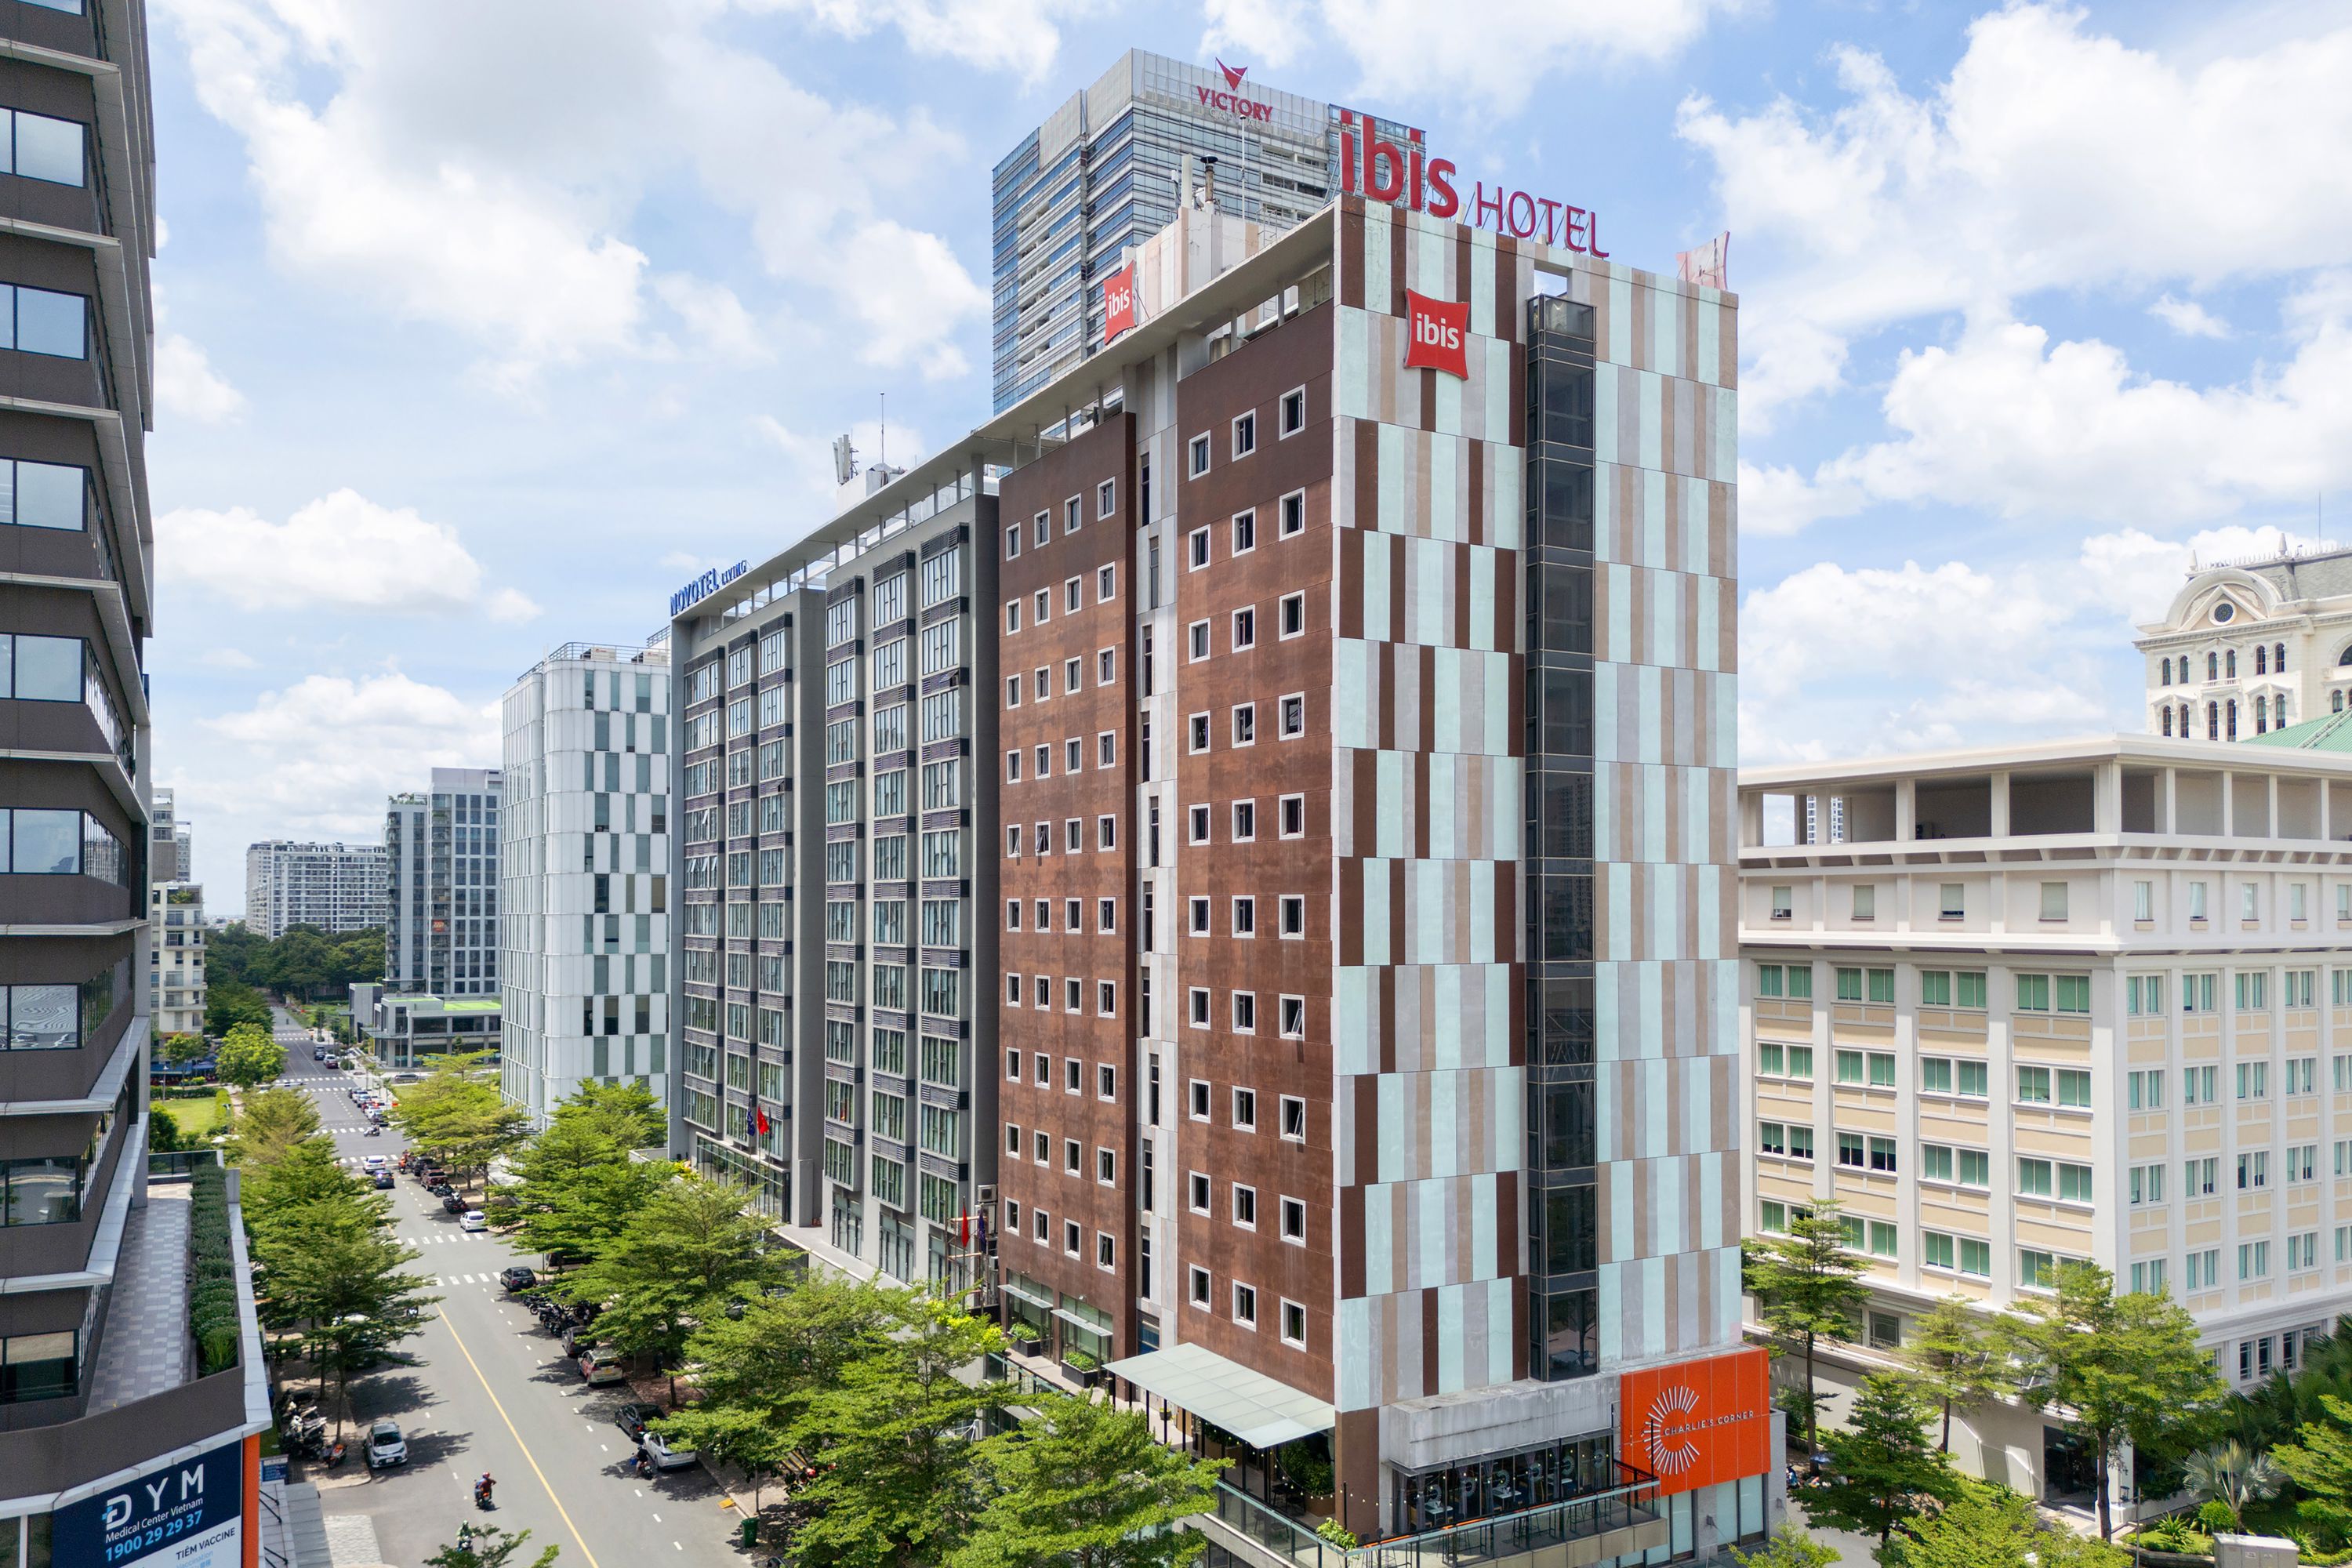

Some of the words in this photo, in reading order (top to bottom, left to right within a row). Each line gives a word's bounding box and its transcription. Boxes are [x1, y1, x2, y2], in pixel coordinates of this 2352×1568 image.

[1196, 85, 1273, 122] VICTORY
[1209, 108, 1261, 129] CAPAL
[1339, 109, 1459, 219] ibis
[1475, 181, 1610, 259] HOTEL
[1107, 286, 1131, 319] ibis
[1416, 312, 1460, 350] ibis
[670, 568, 719, 617] NOVOTEL
[721, 559, 746, 586] LIVING
[1664, 1419, 1714, 1436] CHARLIE'S
[1717, 1410, 1754, 1425] CORNER
[102, 1464, 204, 1530] DYM
[106, 1521, 140, 1543] Medical
[141, 1511, 169, 1529] Center
[170, 1497, 204, 1515] Vietnam
[106, 1535, 142, 1561] 1900
[145, 1526, 163, 1546] 29
[165, 1518, 183, 1537] 29
[186, 1509, 203, 1529] 37
[176, 1544, 198, 1560] TIÊM
[199, 1527, 235, 1550] VACCINE
